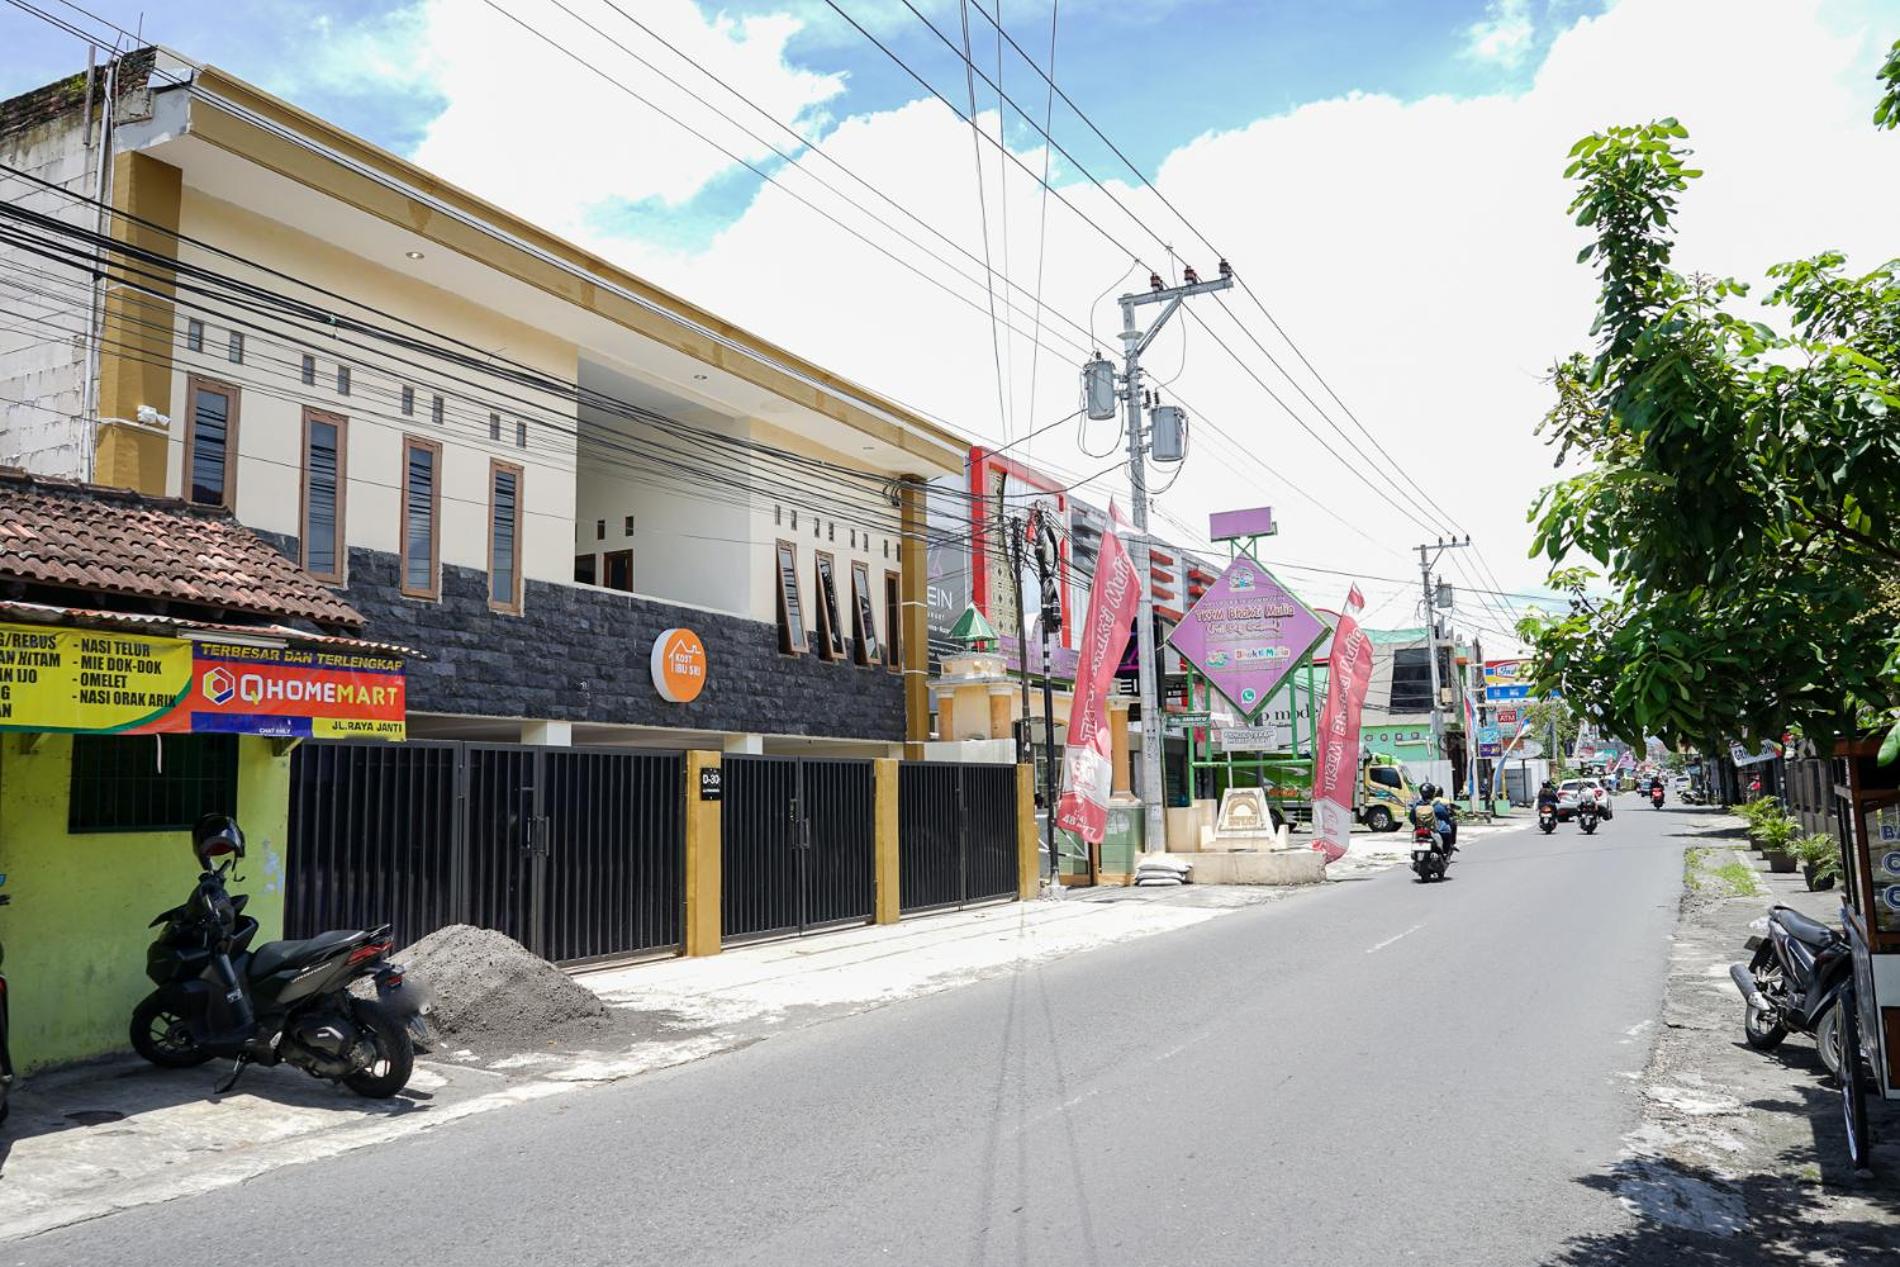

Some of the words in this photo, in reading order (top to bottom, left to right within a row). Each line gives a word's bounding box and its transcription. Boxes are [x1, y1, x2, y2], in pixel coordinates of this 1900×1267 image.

[81, 638, 111, 654] NASI
[114, 640, 150, 657] TELUR
[18, 651, 61, 667] HITAM
[81, 655, 104, 670] MIE
[107, 657, 162, 674] DOK-DOK
[200, 643, 280, 660] TERBESAR
[284, 651, 312, 664] DAN
[317, 653, 404, 671] TERLENGKAP
[675, 653, 692, 663] KOST
[17, 669, 37, 684] IJO
[673, 663, 688, 675] IBU
[80, 672, 127, 688] OMELET
[240, 673, 399, 706] QHOMEMART
[80, 689, 110, 704] NASI
[113, 691, 146, 706] ORAK
[148, 693, 177, 708] ARIK
[377, 723, 402, 733] JANTI
